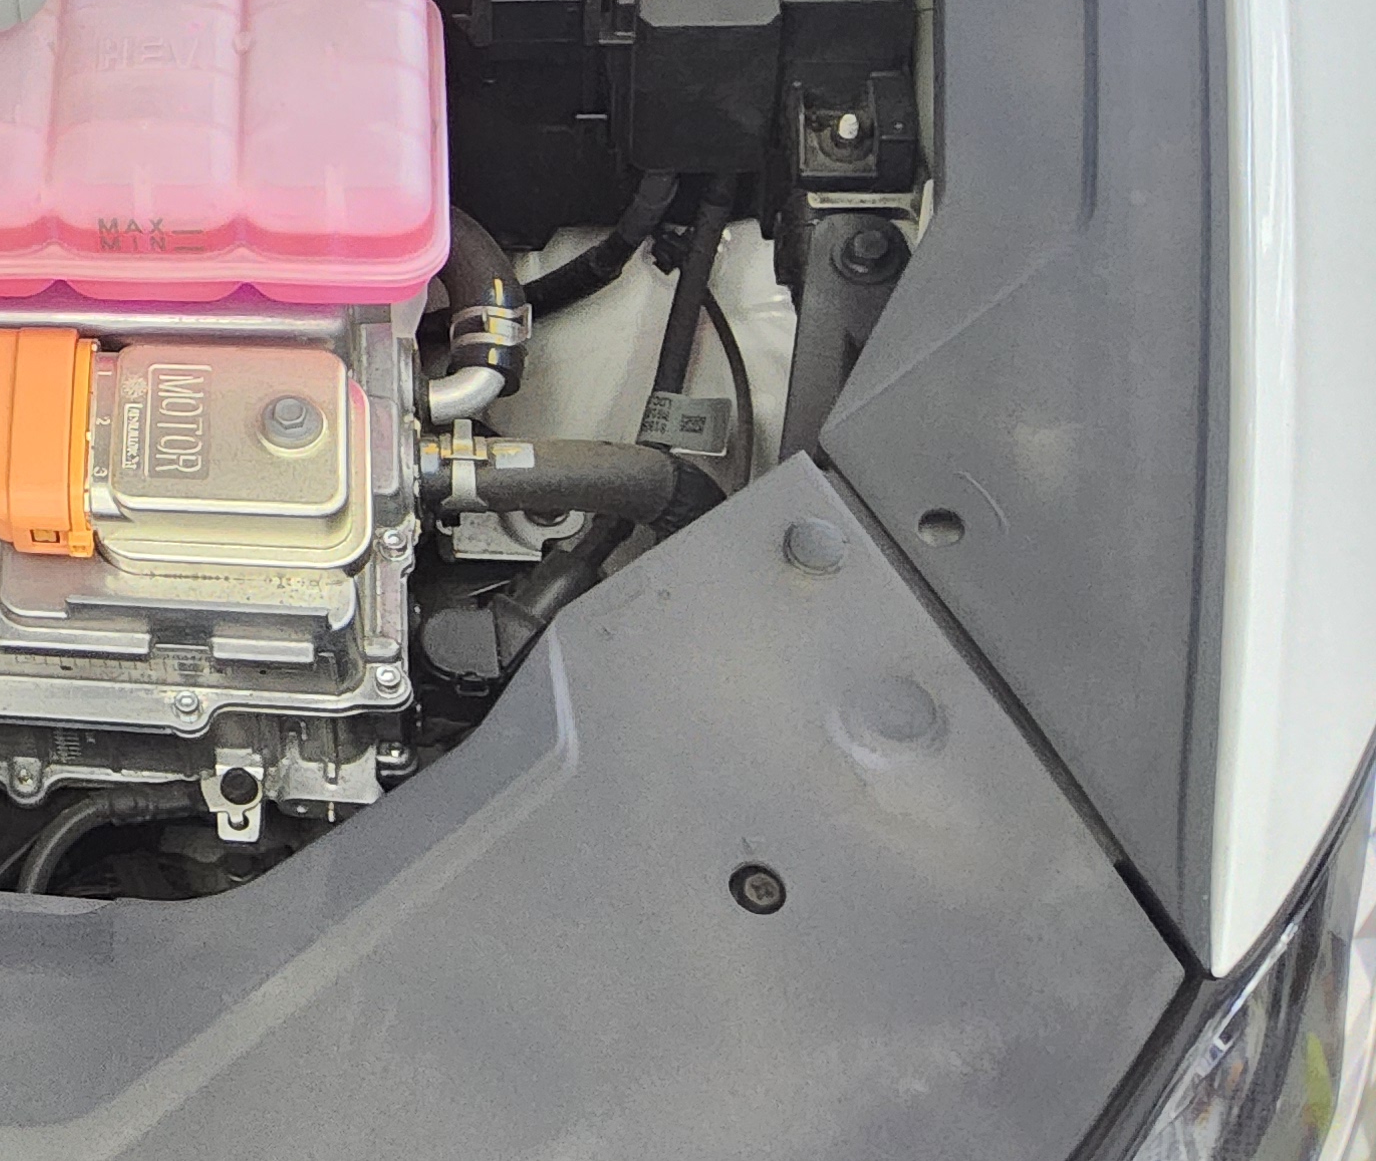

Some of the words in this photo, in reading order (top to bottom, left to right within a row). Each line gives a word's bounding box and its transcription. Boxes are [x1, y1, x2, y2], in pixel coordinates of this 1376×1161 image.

[98, 218, 165, 235] MAX
[101, 236, 167, 253] MIN
[155, 375, 205, 473] MOTOR
